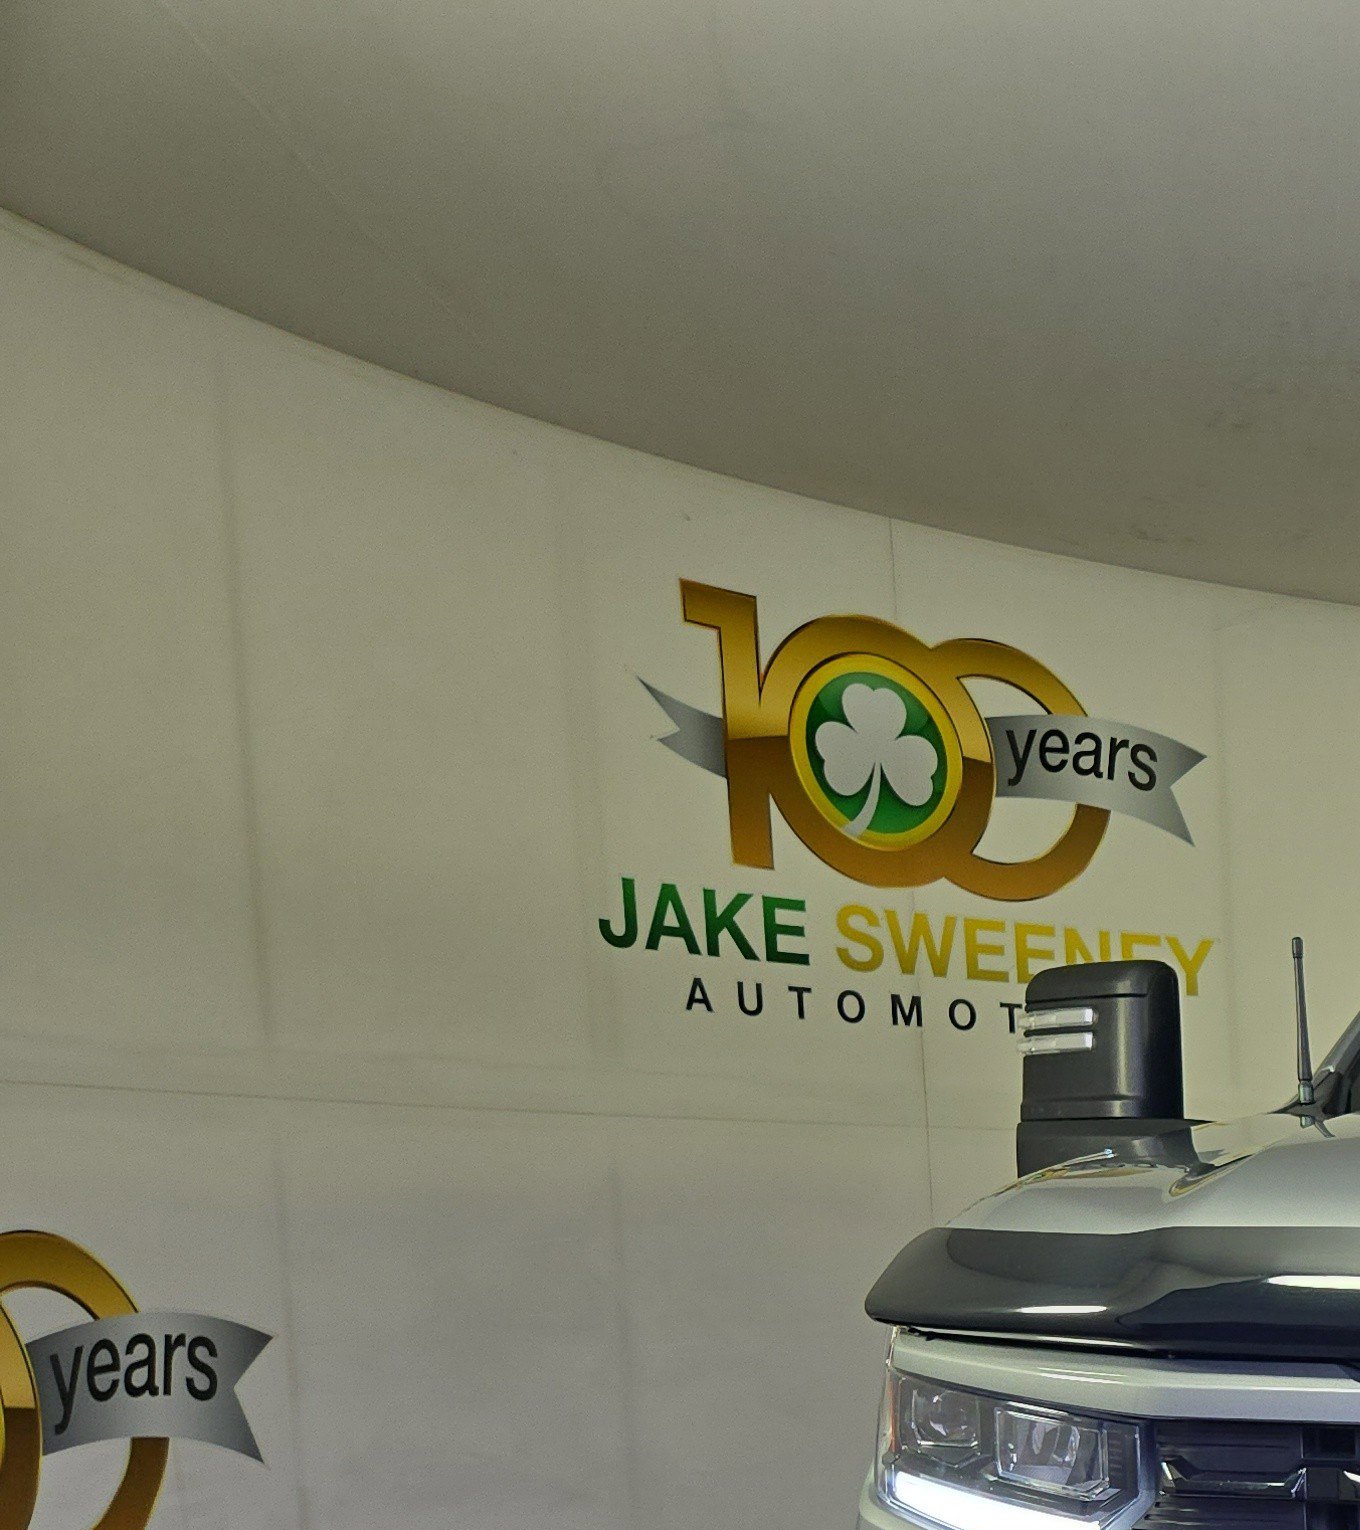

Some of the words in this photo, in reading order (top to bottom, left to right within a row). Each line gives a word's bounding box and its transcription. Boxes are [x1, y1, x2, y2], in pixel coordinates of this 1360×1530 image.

[1005, 726, 1158, 792] years
[597, 876, 811, 967] JAKE
[685, 976, 1024, 1035] AUTOMOT
[49, 1332, 220, 1436] years
